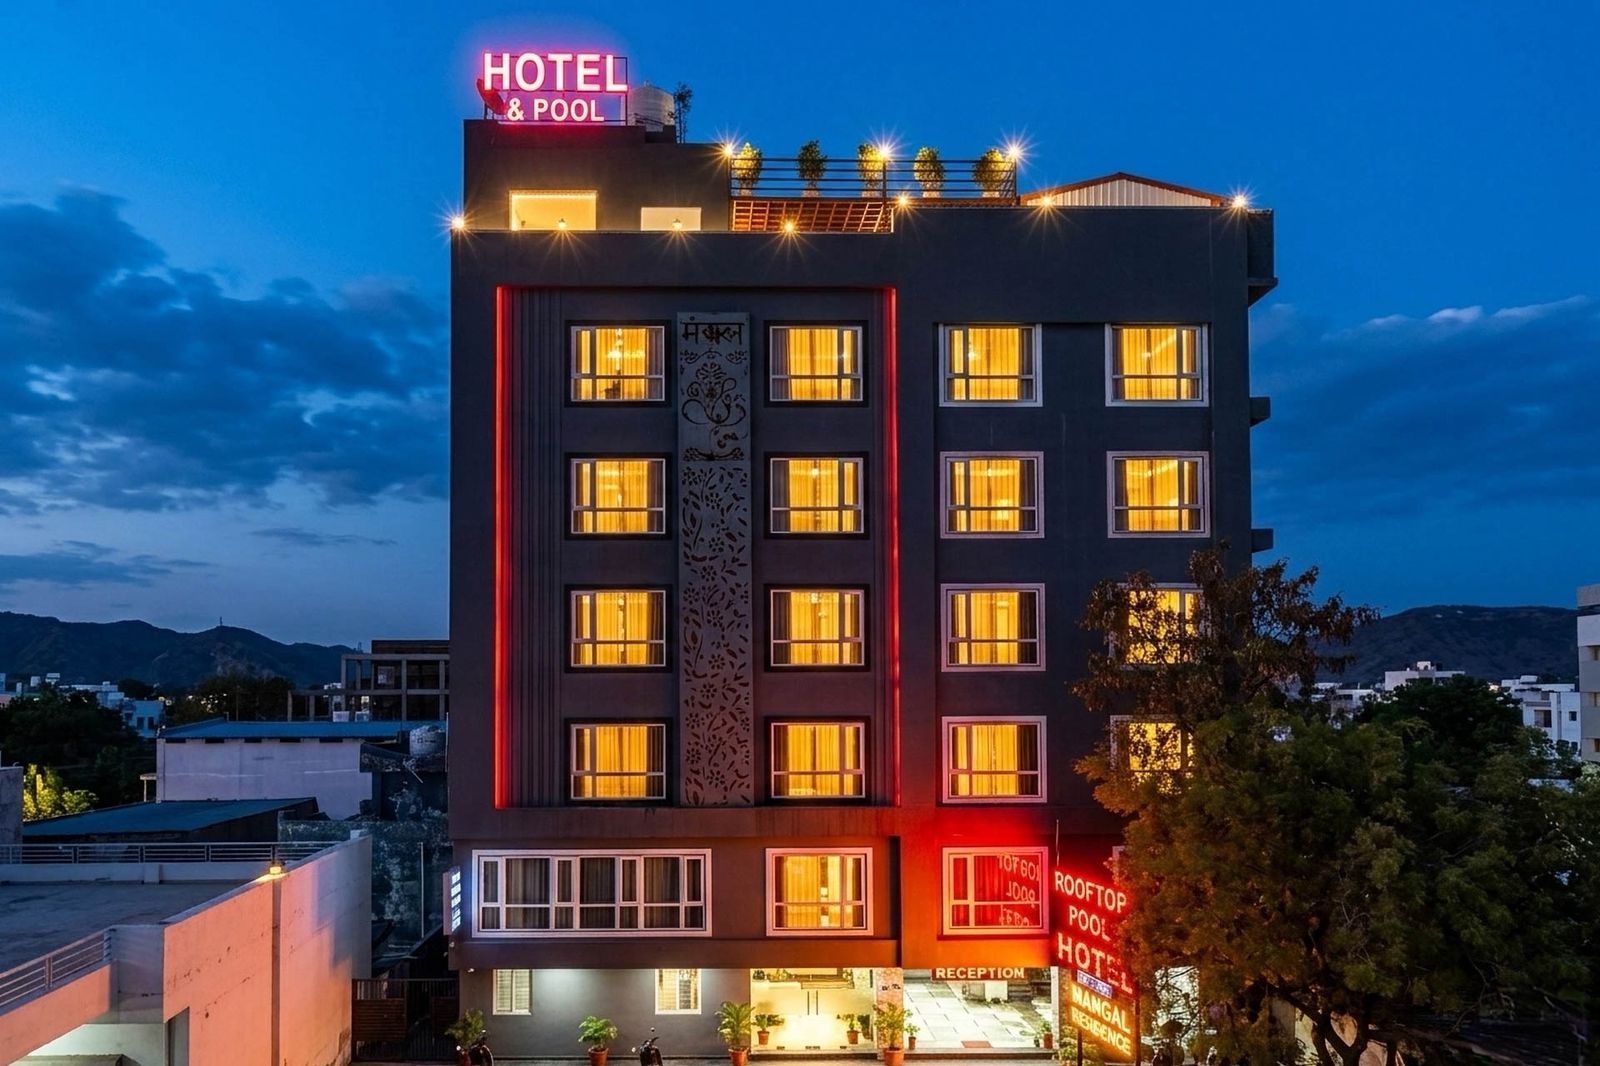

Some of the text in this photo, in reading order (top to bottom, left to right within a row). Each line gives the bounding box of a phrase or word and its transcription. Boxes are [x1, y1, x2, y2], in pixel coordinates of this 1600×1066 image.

[484, 52, 628, 92] HOTEL
[506, 98, 605, 122] & POOL
[1055, 871, 1127, 913] ROOFTOP
[1069, 905, 1112, 941] POOL
[935, 967, 1025, 979] RECEPTION
[1058, 932, 1133, 994] HOTEL
[1071, 983, 1131, 1034] MANGAL
